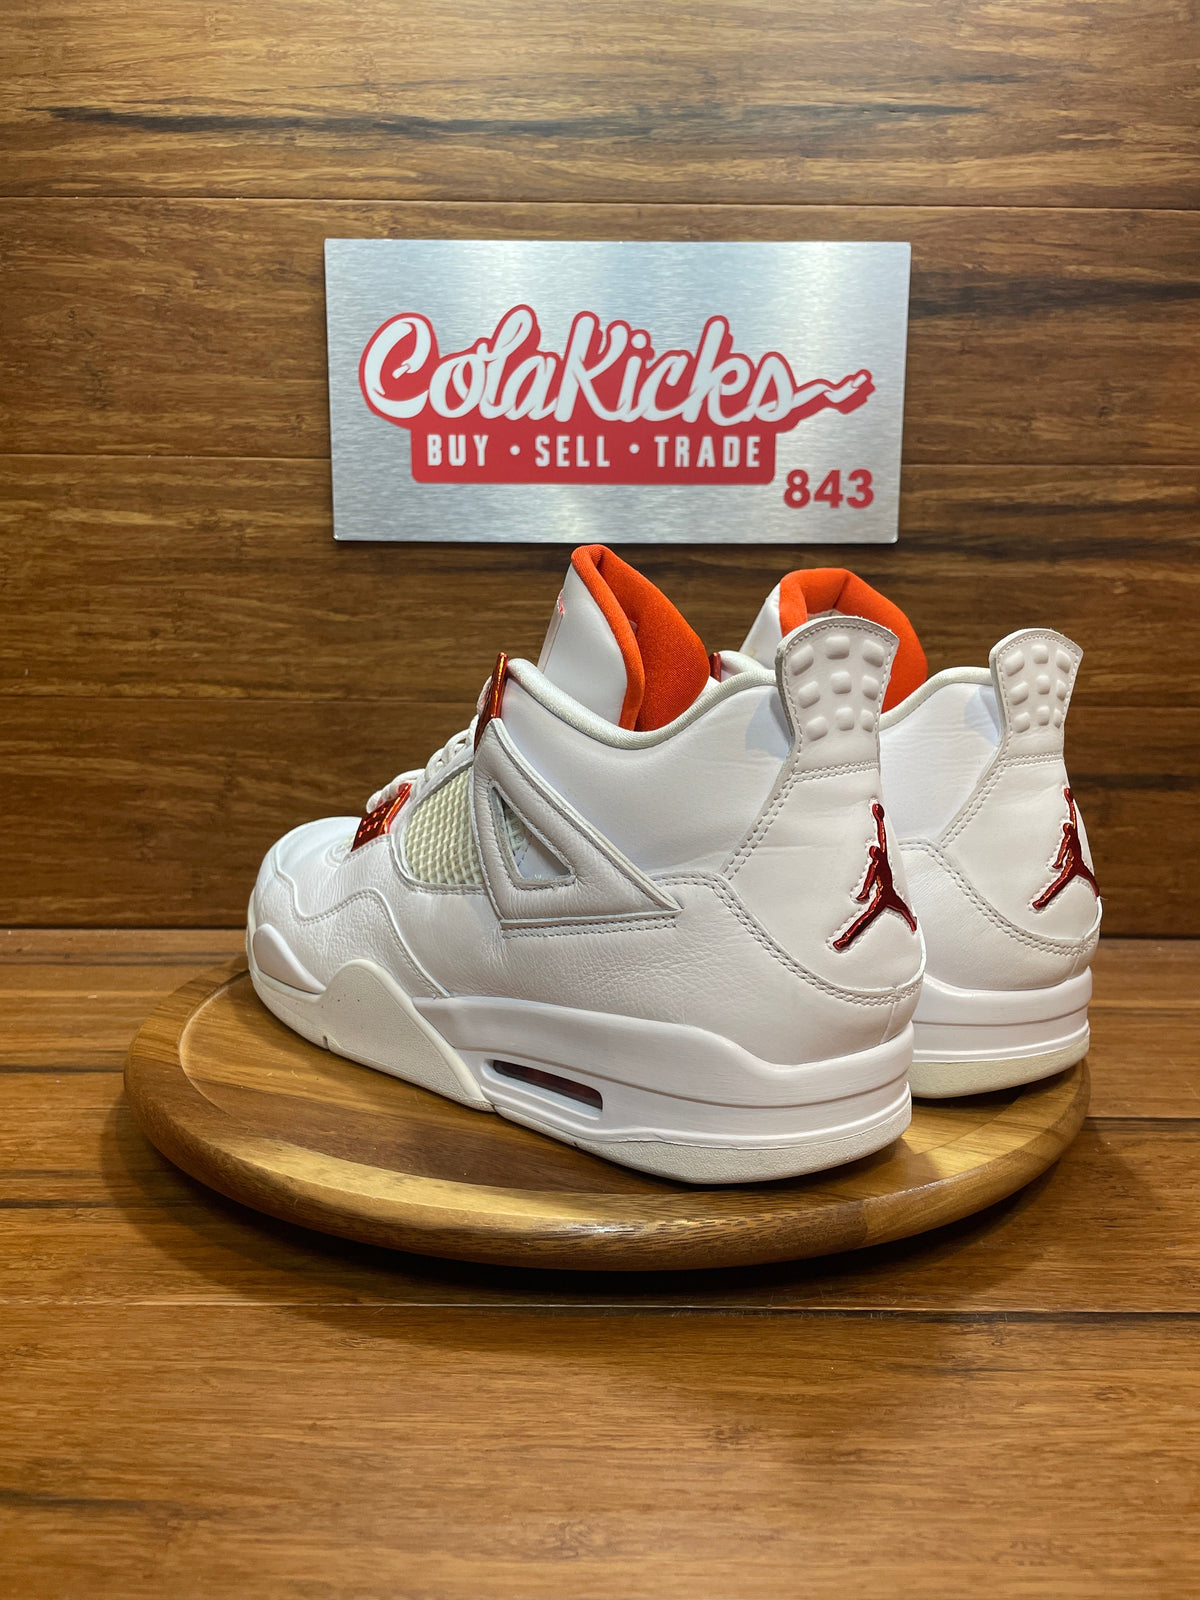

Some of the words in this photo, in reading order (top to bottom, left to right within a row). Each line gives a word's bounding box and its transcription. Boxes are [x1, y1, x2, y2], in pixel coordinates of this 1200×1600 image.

[360, 306, 873, 427] ColaKicks
[426, 433, 490, 467] BUY
[534, 435, 611, 468] SELL
[654, 435, 762, 468] TRADE
[782, 469, 875, 509] 843
